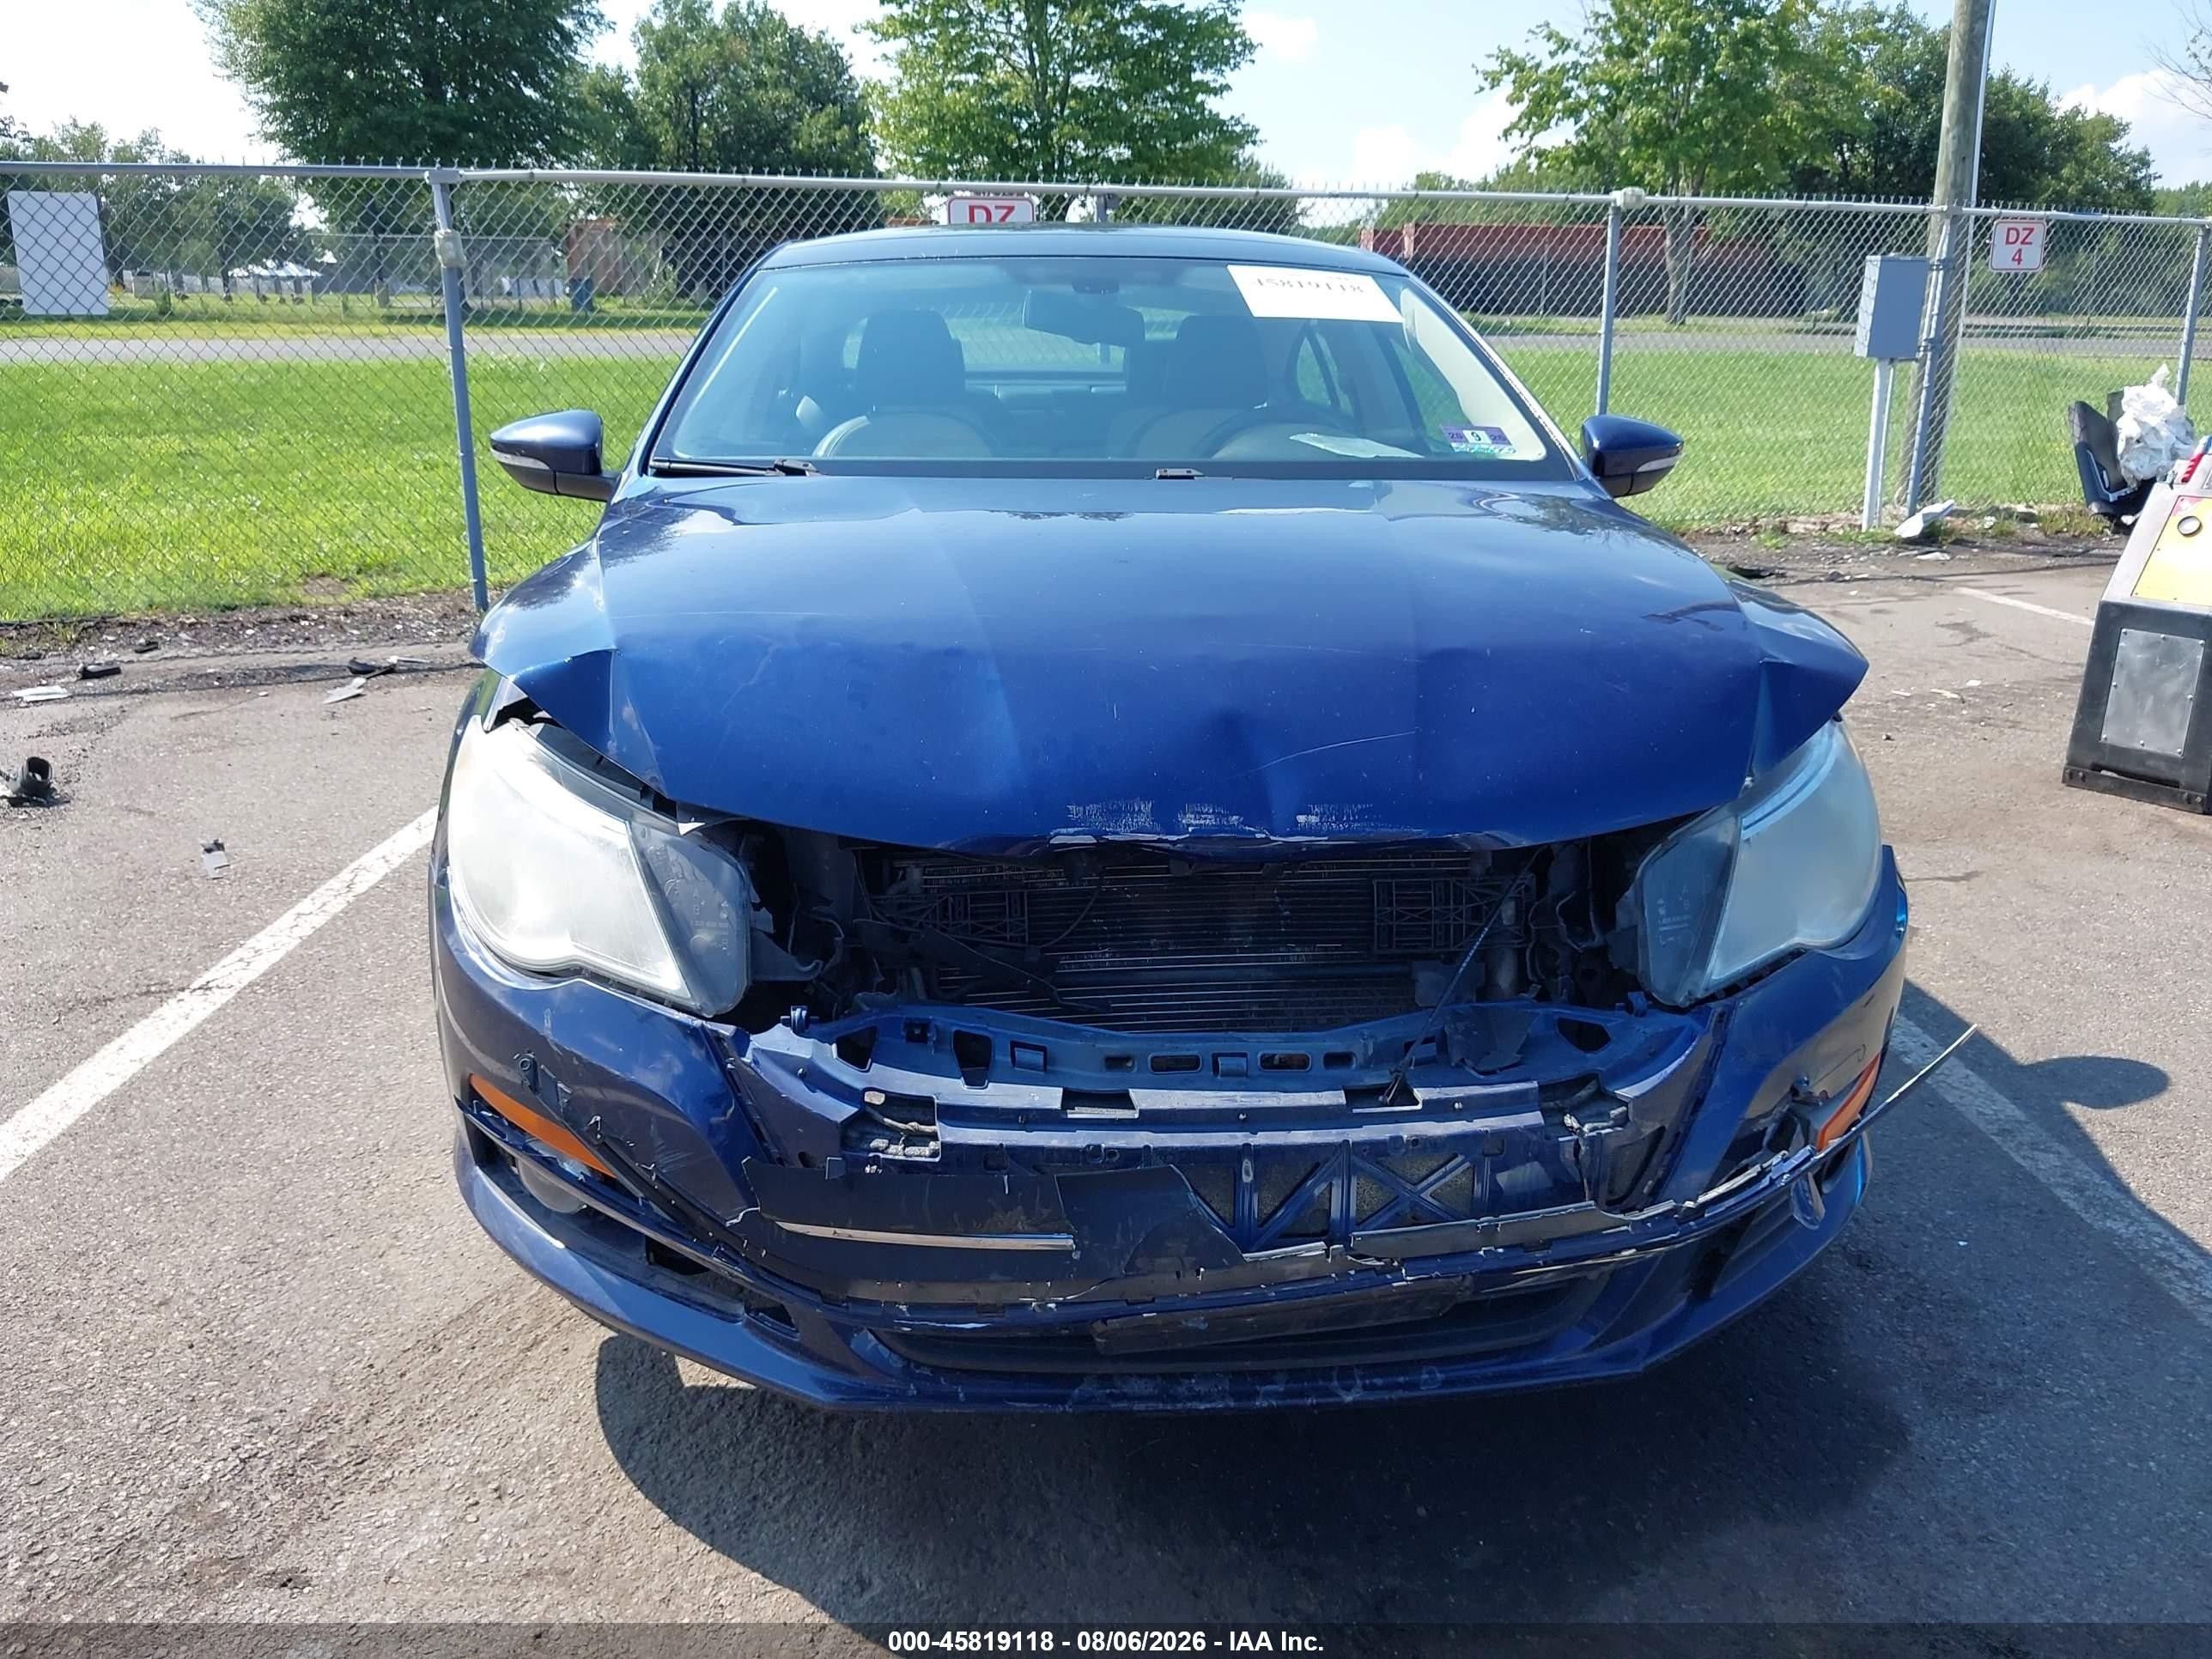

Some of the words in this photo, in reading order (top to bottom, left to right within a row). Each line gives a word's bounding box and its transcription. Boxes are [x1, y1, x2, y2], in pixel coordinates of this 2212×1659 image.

[968, 204, 1016, 224] DZ
[2004, 227, 2035, 246] DZ
[2011, 247, 2023, 265] 4
[1470, 431, 1482, 442] 9
